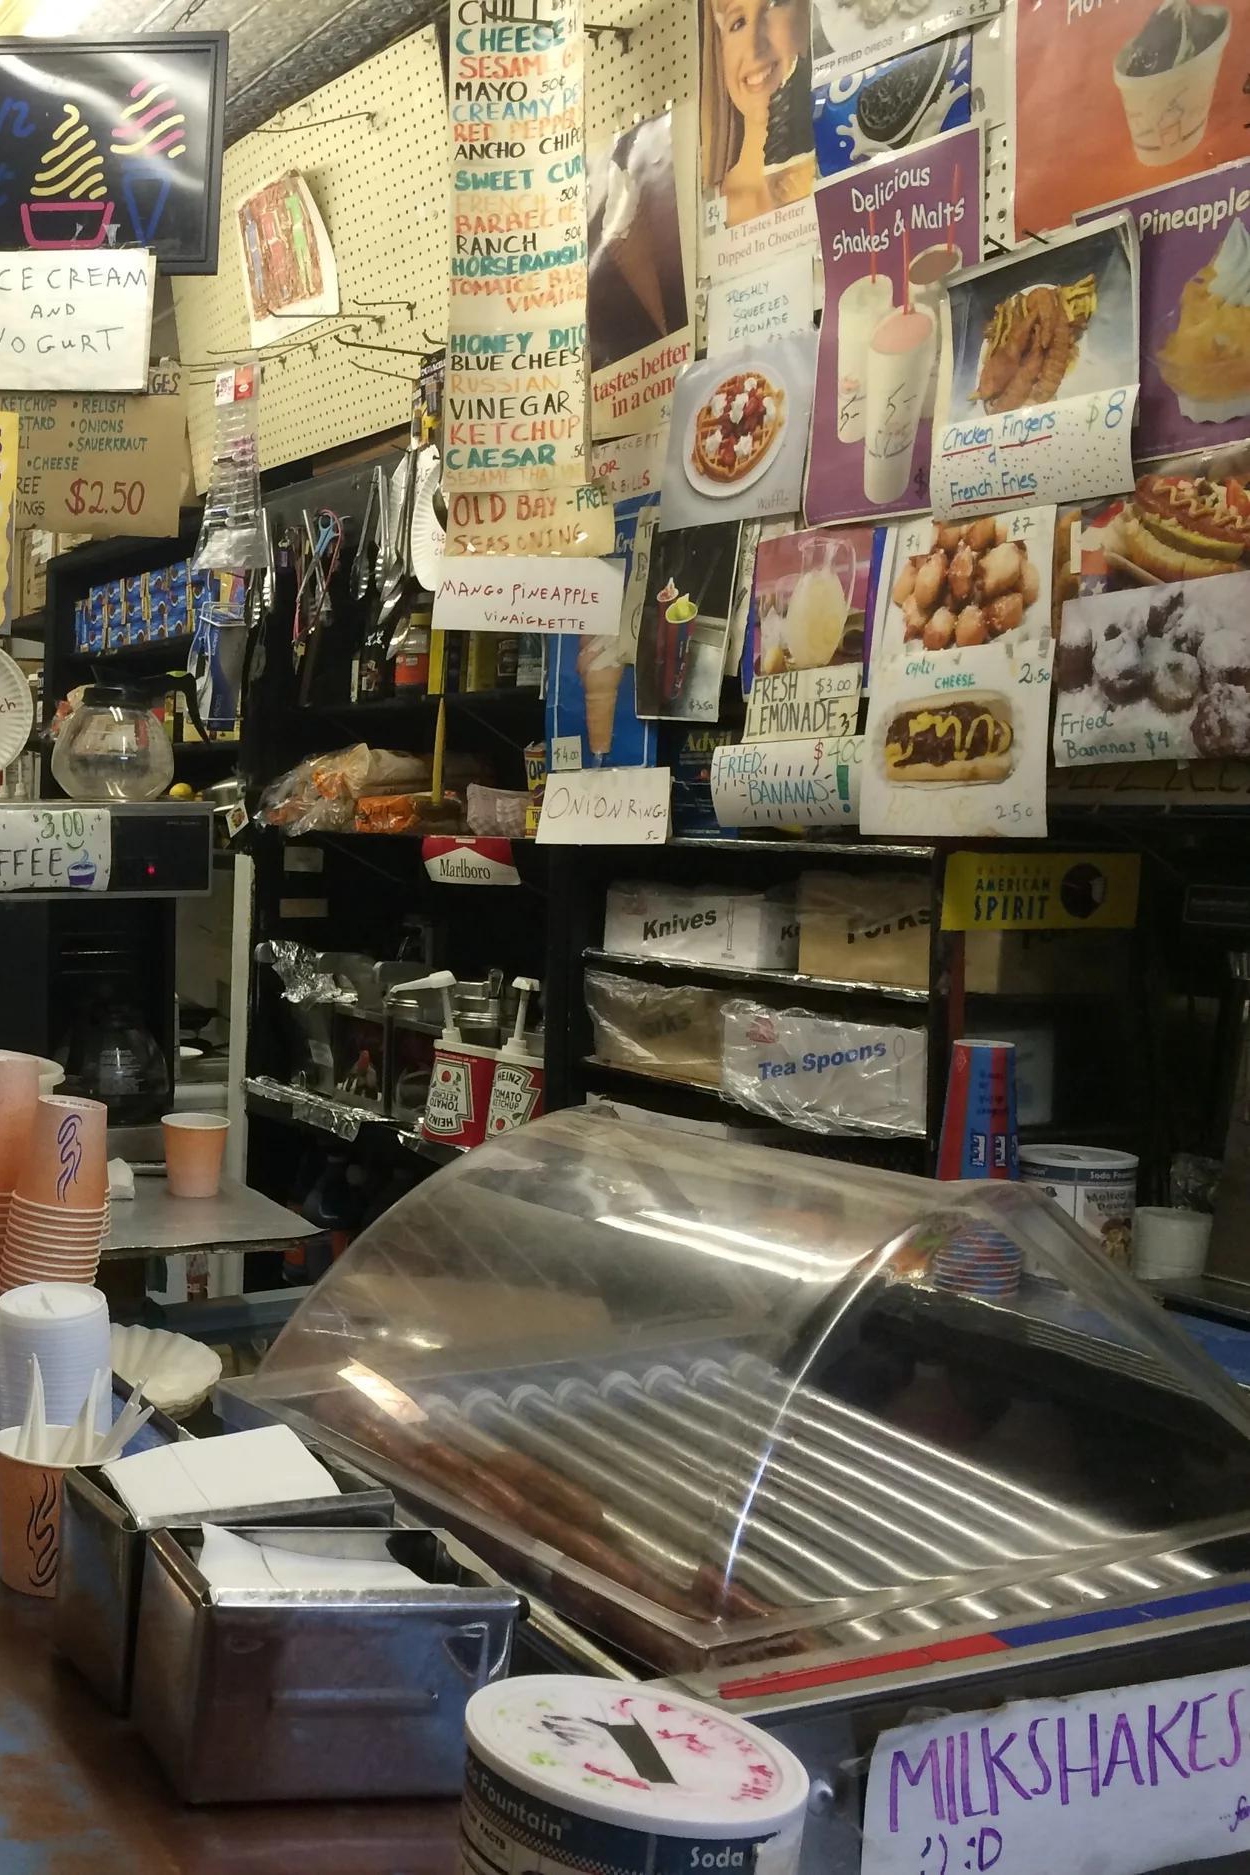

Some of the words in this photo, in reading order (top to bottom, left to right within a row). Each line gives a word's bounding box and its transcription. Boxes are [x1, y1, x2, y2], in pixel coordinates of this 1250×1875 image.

[456, 18, 565, 55] CHEESE
[837, 49, 863, 67] FRIED
[864, 36, 893, 54] OREOS
[455, 81, 528, 102] MAYO
[452, 95, 555, 124] CREAMY
[454, 142, 526, 161] ANCHO
[454, 169, 534, 191] SWEET
[851, 164, 931, 214] Delicious
[455, 193, 547, 214] FRENCH
[708, 205, 720, 220] $4
[1138, 187, 1250, 242] Pineapple
[730, 229, 738, 242] It
[740, 220, 772, 238] Tastes
[774, 205, 806, 225] Better
[833, 226, 890, 262] Shakes
[893, 211, 906, 237] &
[911, 197, 965, 232] Malts
[456, 232, 537, 257] RANCH
[717, 243, 752, 266] Dipped
[755, 240, 765, 253] In
[767, 221, 818, 247] Chocolate
[47, 267, 148, 290] CREAM
[726, 281, 769, 304] FRESHLY
[30, 303, 76, 320] AND
[733, 295, 789, 323] SQUEEZED
[728, 313, 789, 342] LEMONADE
[451, 331, 534, 355] HONEY
[450, 354, 504, 372] BLUE
[593, 367, 639, 403] tastes
[641, 342, 690, 383] better
[451, 373, 560, 394] RUSSIAN
[1, 397, 57, 412] KETCHUP
[81, 399, 126, 414] RELISH
[449, 391, 572, 420] VINEGAR
[612, 397, 628, 419] in
[631, 392, 641, 410] a
[79, 419, 124, 433] ONIONS
[450, 415, 580, 445] KETCHUP
[943, 424, 994, 452] Chicken
[1002, 409, 1056, 443] Fingers
[76, 437, 148, 452] SAUERKRAUT
[615, 433, 660, 450] ACCEPT
[33, 456, 79, 471] CHEESE
[446, 444, 556, 470] CAESAR
[598, 460, 620, 477] OR
[446, 468, 513, 486] SESAME
[950, 481, 993, 501] French
[1001, 472, 1038, 497] Fries
[65, 478, 145, 516] $2.50
[453, 493, 506, 526] OLD
[517, 495, 558, 520] BAY
[1012, 517, 1036, 533] $7
[453, 523, 588, 554] SEASONING
[438, 580, 503, 600] MANGO
[935, 673, 976, 690] CHEESE
[1018, 662, 1050, 684] 2.50
[752, 671, 798, 705] FRESH
[815, 677, 851, 697] $3.00
[746, 700, 839, 737] LEMONADE
[1059, 707, 1114, 737] Fried
[686, 731, 732, 752] Advil
[1066, 739, 1136, 760] Bananas
[553, 746, 579, 763] $4.00
[716, 752, 763, 785] FRIED
[439, 858, 491, 880] Marlboro
[975, 877, 1051, 892] AMERICAN
[974, 895, 1049, 921] SPIRIT
[642, 909, 717, 941] Knives
[758, 1061, 796, 1080] Tea
[802, 1041, 887, 1072] Spoons
[497, 1071, 522, 1086] HEINZ
[430, 1098, 459, 1112] TOMATO
[432, 1091, 459, 1100] KETCHUP
[493, 1088, 522, 1103] TOMATO
[493, 1098, 519, 1110] KETCHUP
[429, 1114, 454, 1127] HEINZ
[1090, 1171, 1111, 1180] Soda
[1086, 1189, 1126, 1203] Malted
[889, 1688, 1246, 1833] MILKSHAKES
[479, 1772, 562, 1841] Fountain
[690, 1846, 745, 1869] Soda
